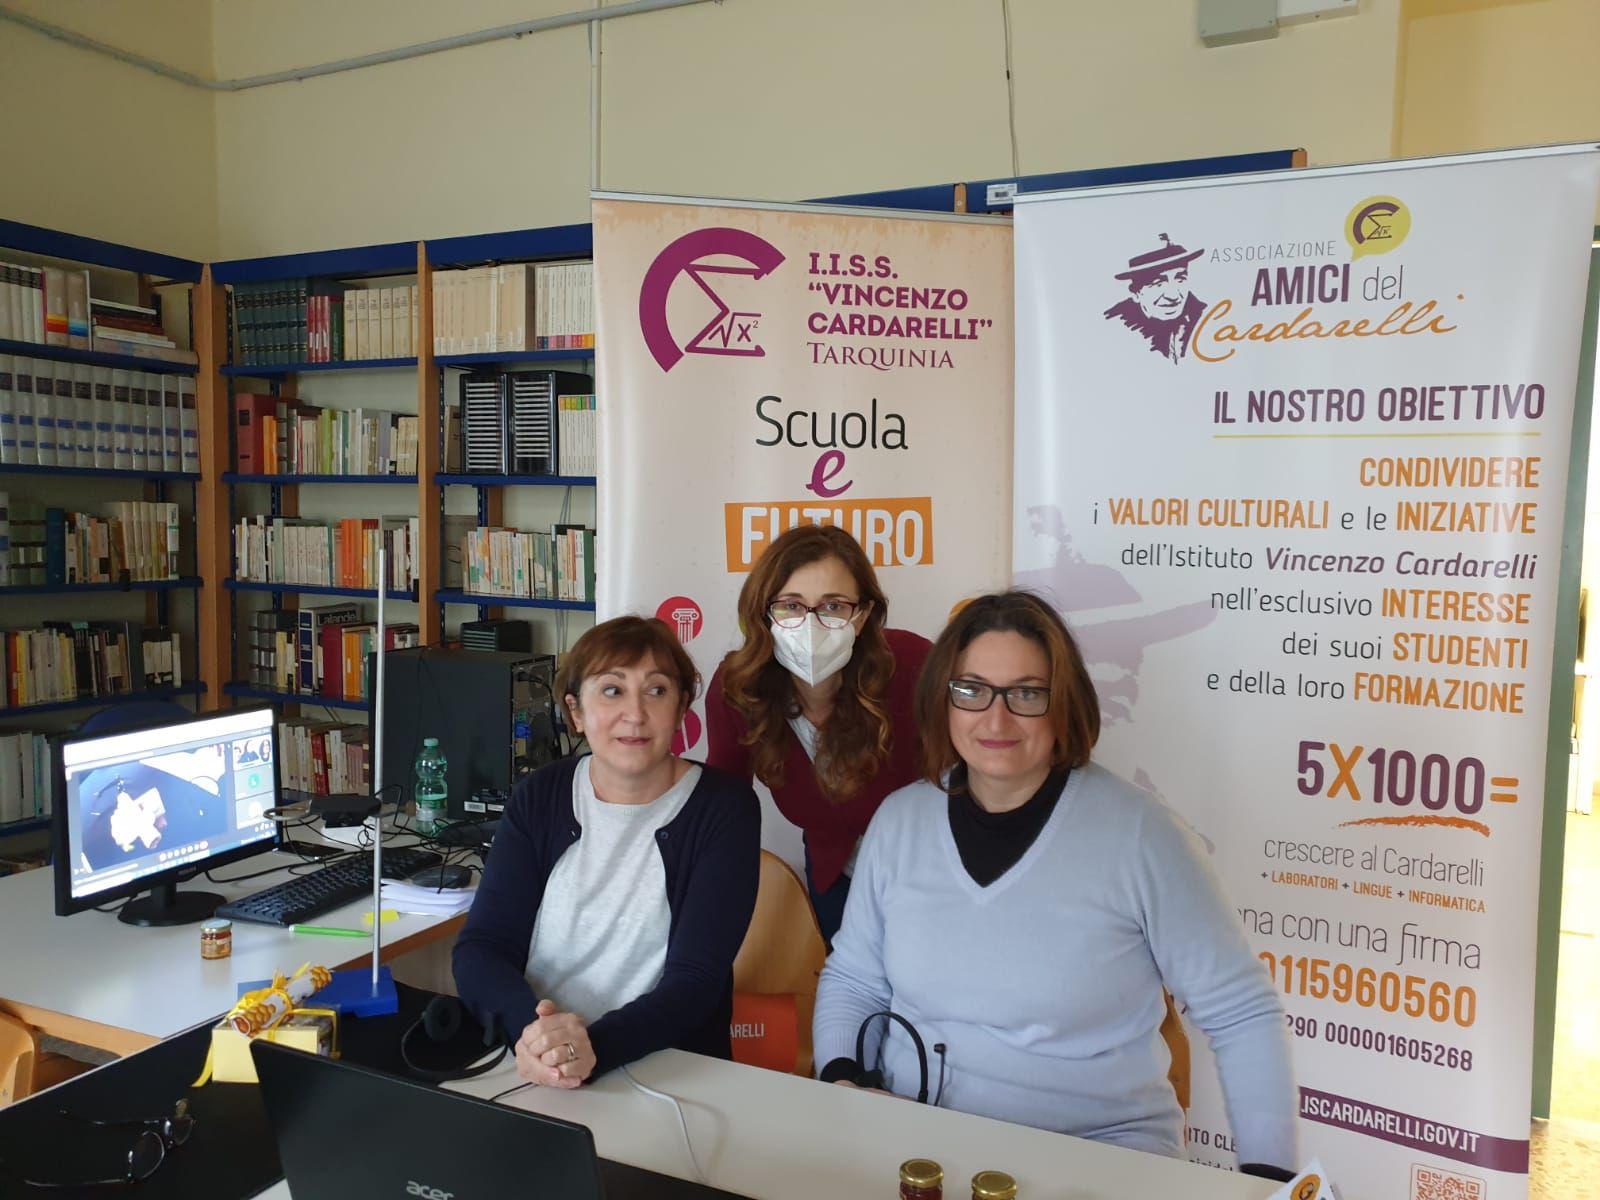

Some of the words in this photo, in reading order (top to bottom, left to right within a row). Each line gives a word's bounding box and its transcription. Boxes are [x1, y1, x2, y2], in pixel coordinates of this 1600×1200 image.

[808, 252, 899, 279] I.I.S.S.
[1210, 240, 1337, 263] ASSOCIAZIONE
[1251, 263, 1351, 307] AMICI
[1362, 264, 1404, 301] del
[1191, 293, 1465, 363] Cardarelli
[755, 395, 909, 450] Scuola
[1214, 391, 1236, 424] IL
[1247, 388, 1365, 423] NOSTRO
[1378, 383, 1546, 421] OBIETTIVO
[805, 449, 854, 498] e
[1359, 456, 1542, 489] CONDIVIDERE
[1092, 502, 1099, 525] i
[1108, 497, 1190, 527] VALORI
[1199, 499, 1329, 530] CULTURALI
[1340, 511, 1354, 531] e
[1366, 505, 1388, 532] le
[1397, 501, 1537, 534] INIZIATIVE
[1265, 547, 1386, 574] Vincenzo
[1396, 550, 1537, 580] Cardarelli
[1381, 587, 1532, 624] INTERESSE
[1281, 632, 1318, 656] dei
[1329, 635, 1382, 660] suoi
[1392, 632, 1528, 669] STUDENTI
[1206, 671, 1220, 691] e
[1229, 668, 1286, 696] della
[1298, 673, 1345, 700] loro
[1353, 671, 1525, 714] FORMAZIONE
[1264, 838, 1355, 868] crescere
[1360, 844, 1378, 872] al
[1383, 847, 1484, 887] Cardarelli
[1271, 870, 1339, 891] LABORATORI
[1353, 881, 1393, 899] LINGUE
[1408, 889, 1486, 914] INFORMATICA
[1237, 908, 1274, 936] na
[1281, 913, 1330, 944] con
[1338, 924, 1388, 953] una
[1395, 922, 1482, 970] firma
[1325, 1021, 1474, 1072] 000001605268
[406, 1180, 455, 1200] acer
